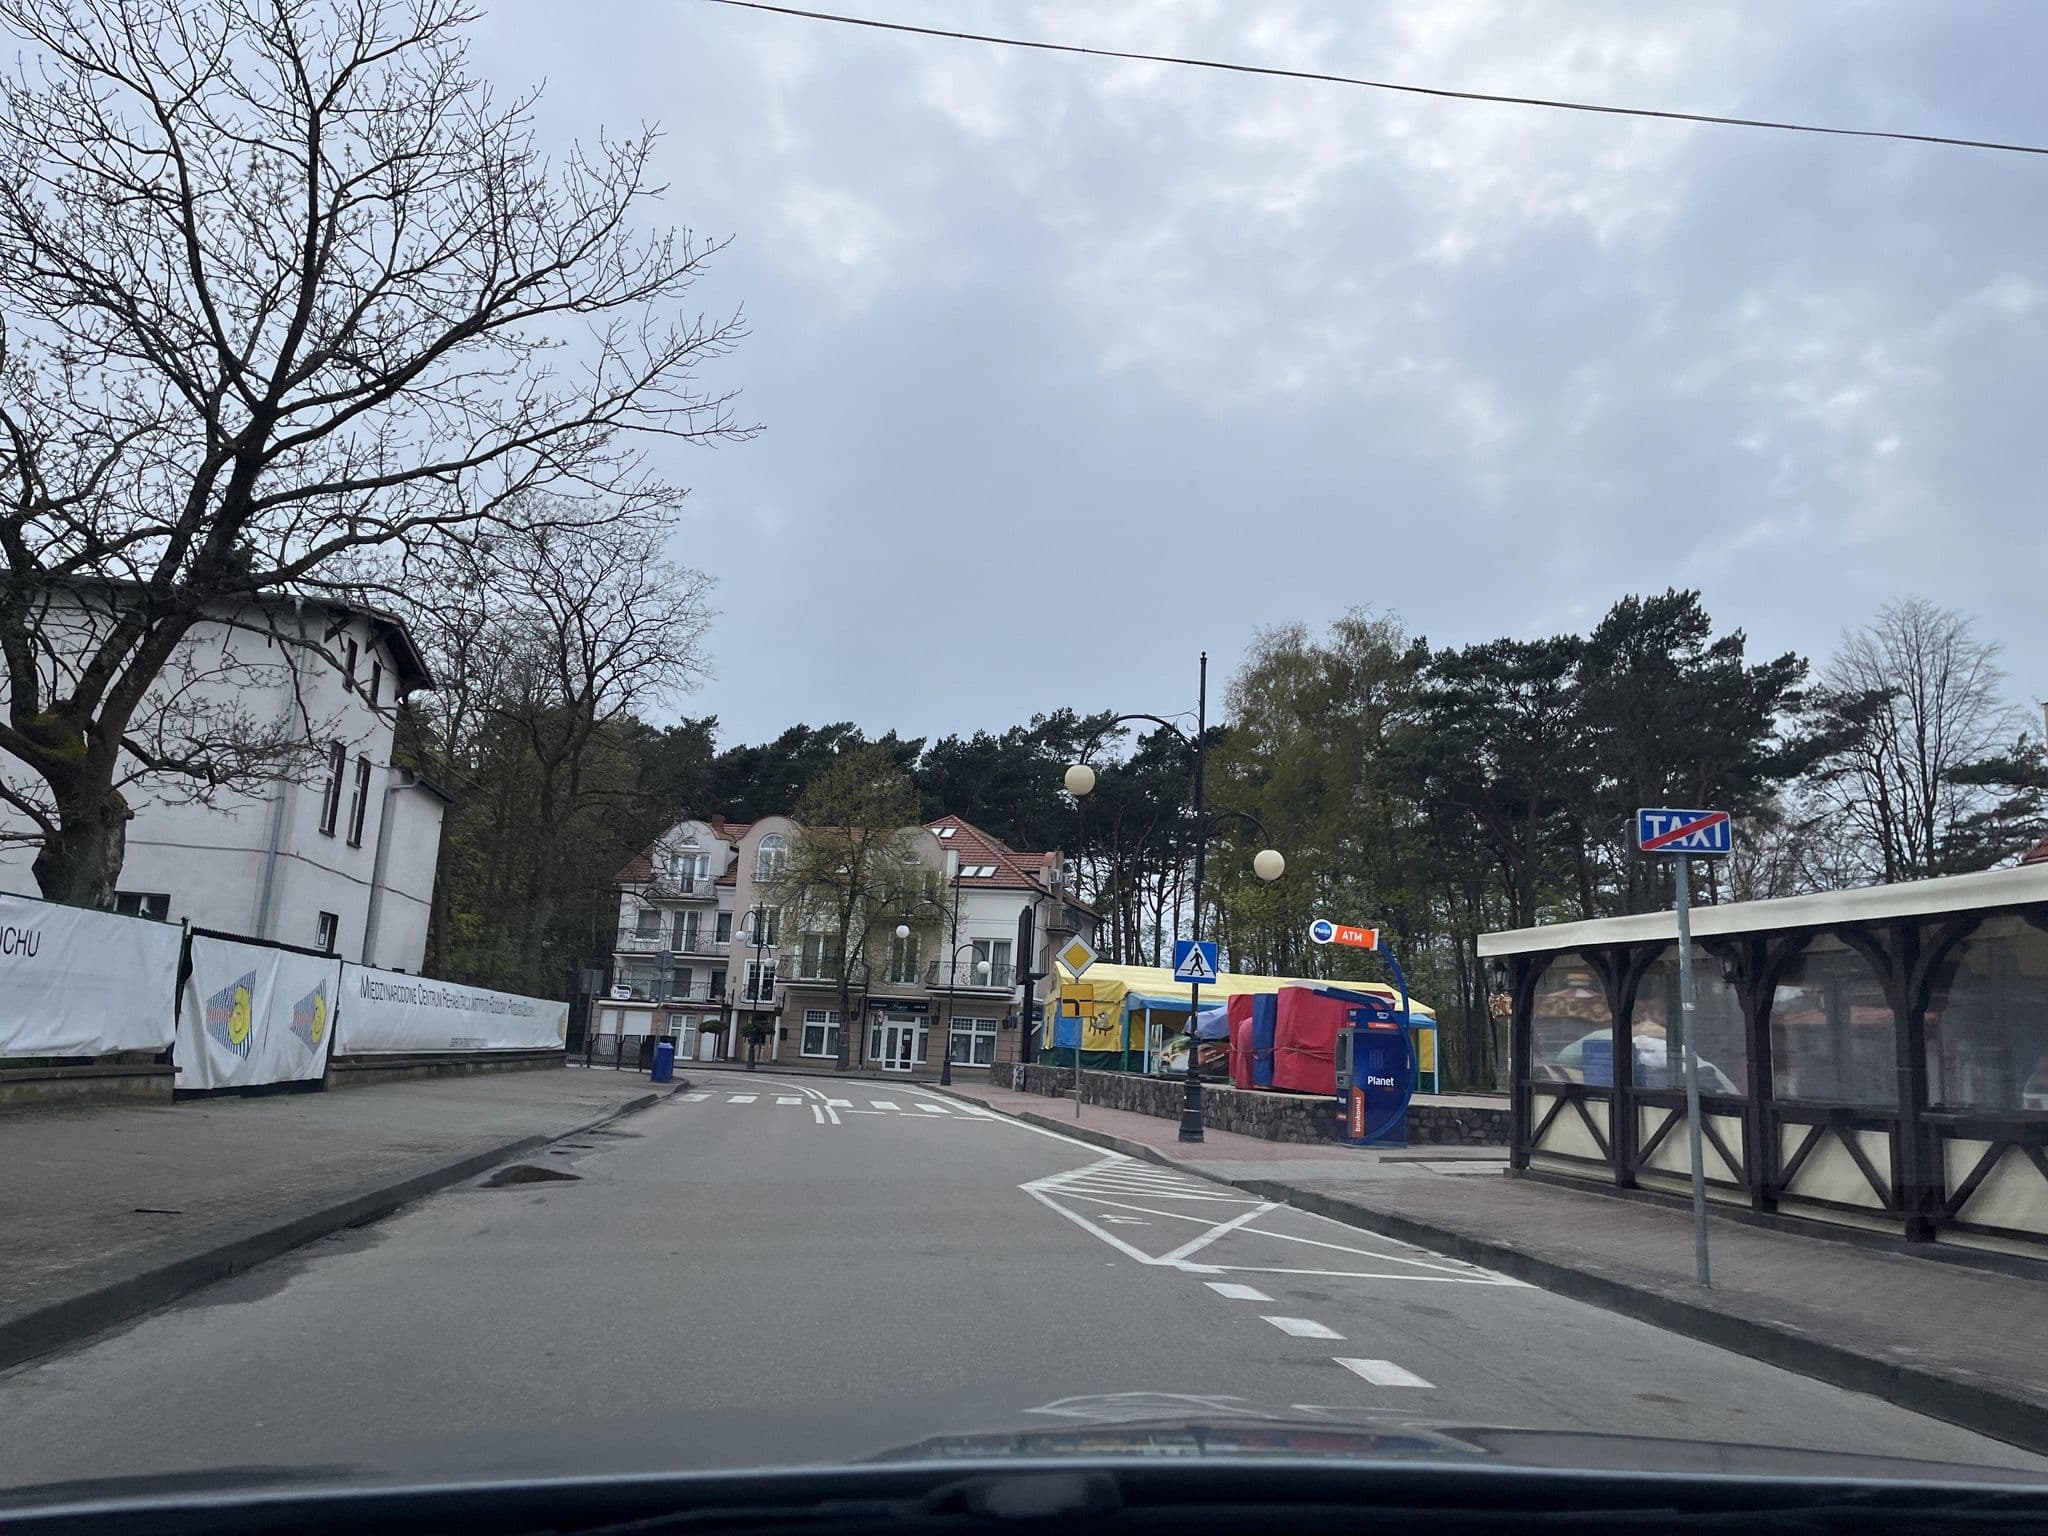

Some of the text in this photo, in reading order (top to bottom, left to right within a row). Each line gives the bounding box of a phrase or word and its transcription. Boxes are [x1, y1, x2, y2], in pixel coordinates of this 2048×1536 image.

[1645, 815, 1722, 848] TAXI
[0, 926, 41, 958] CHU
[1341, 929, 1363, 942] ATM
[1367, 1075, 1394, 1087] Planet
